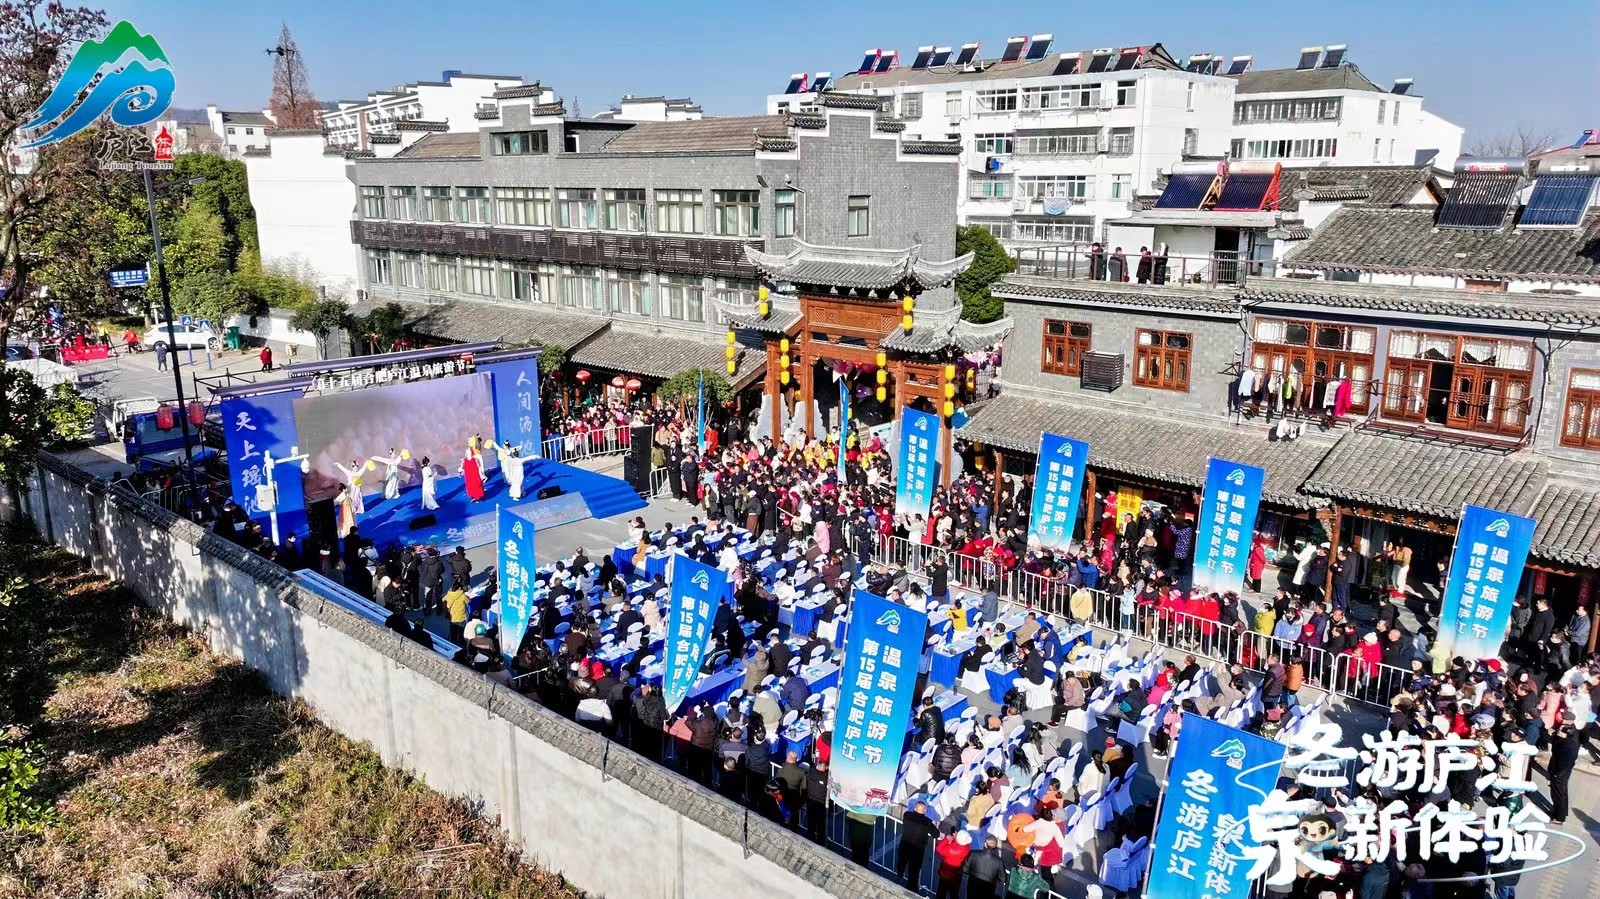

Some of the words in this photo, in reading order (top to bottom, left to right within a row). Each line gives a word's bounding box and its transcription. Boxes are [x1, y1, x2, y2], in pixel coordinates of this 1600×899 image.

[317, 359, 466, 391] 第十五届合肥庐江温泉旅游节
[516, 370, 536, 457] 人间汤池
[236, 411, 262, 516] 天上瑶池
[1037, 461, 1061, 536] 第15届合肥庐江
[1052, 464, 1074, 536] 温泉旅游节
[1207, 490, 1230, 571] 第15届合肥庐江
[1220, 493, 1246, 574] 温泉旅游节
[503, 539, 520, 609] 冬游庐江
[1455, 542, 1489, 635] 第15届合肥庐江
[1471, 546, 1510, 640] 温泉旅游节
[841, 637, 880, 762] 第15届合肥庐江
[863, 644, 902, 765] 温泉旅游节
[1166, 768, 1219, 881] 冬游庐江
[1202, 813, 1247, 899] 泉新体
